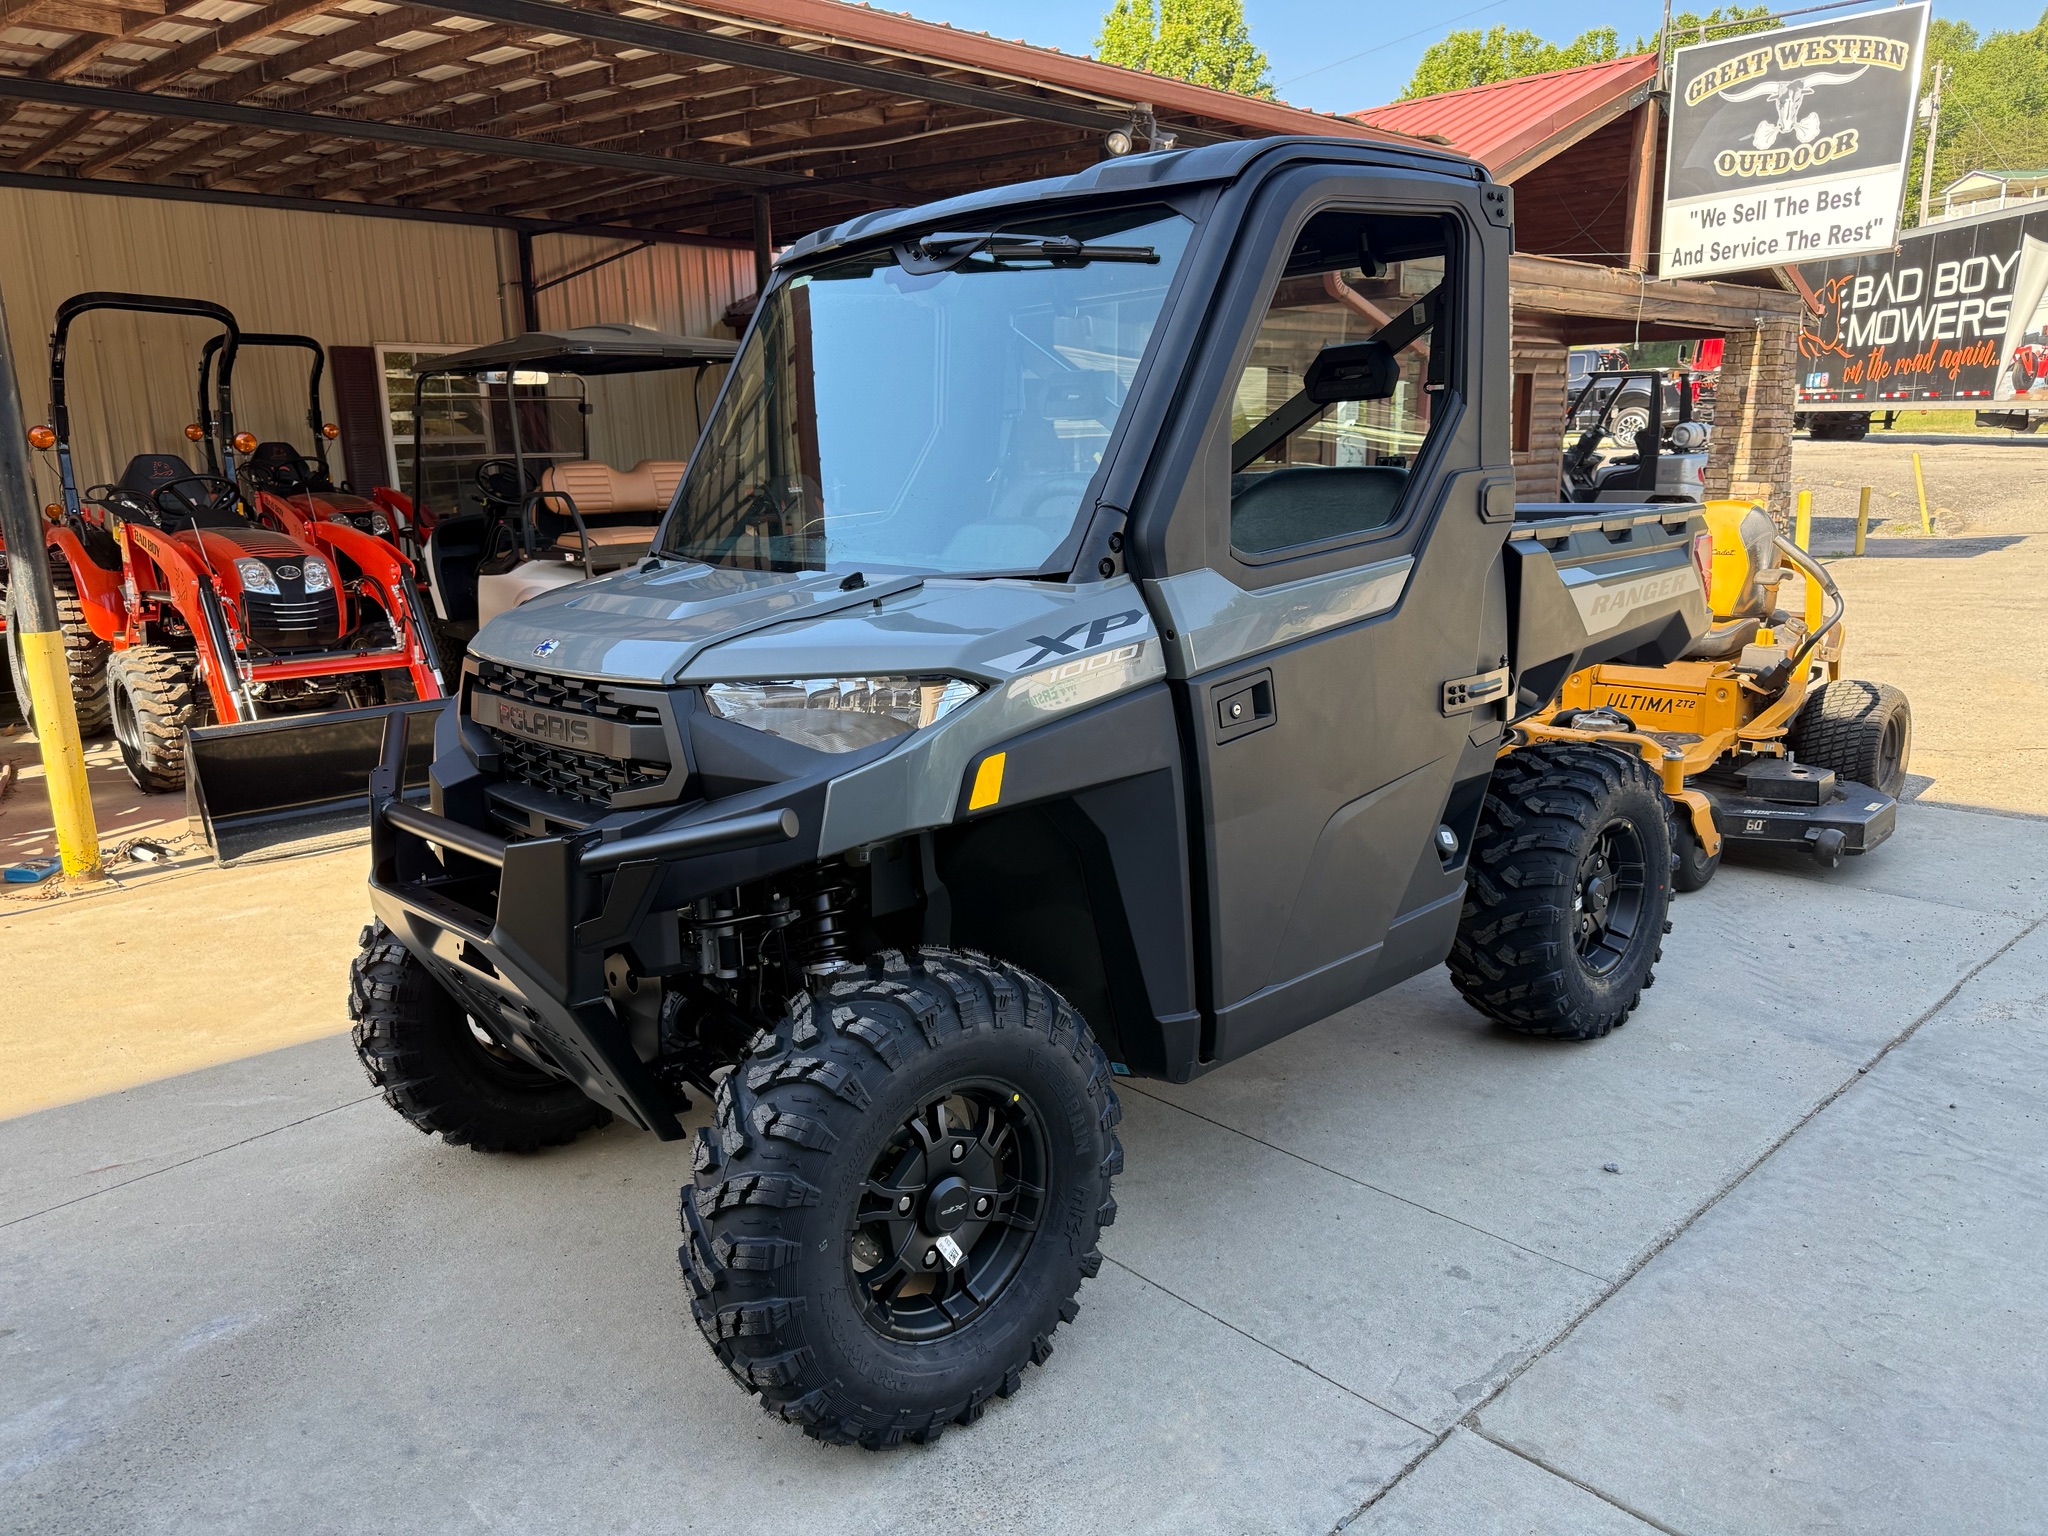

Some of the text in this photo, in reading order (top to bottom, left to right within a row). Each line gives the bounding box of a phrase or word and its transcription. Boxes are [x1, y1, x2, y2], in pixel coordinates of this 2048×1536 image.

[1685, 37, 1907, 105] GREAT WESTERN
[1716, 130, 1858, 175] OUTDOOR
[1690, 186, 1862, 229] "We Sell The Best
[1671, 217, 1884, 268] And Service The Rest"
[1852, 250, 2021, 309] BAD BOY
[1846, 294, 2013, 348] MOWERS
[1843, 359, 1864, 384] on
[1866, 345, 1891, 383] the
[1894, 337, 1940, 376] road
[134, 530, 161, 558] BAD BOY
[1590, 573, 1687, 617] RANGER
[1015, 608, 1145, 670] XP
[1049, 643, 1140, 684] 1000
[499, 704, 590, 747] POLARIS
[1606, 692, 1696, 714] ULTIMA ZT2
